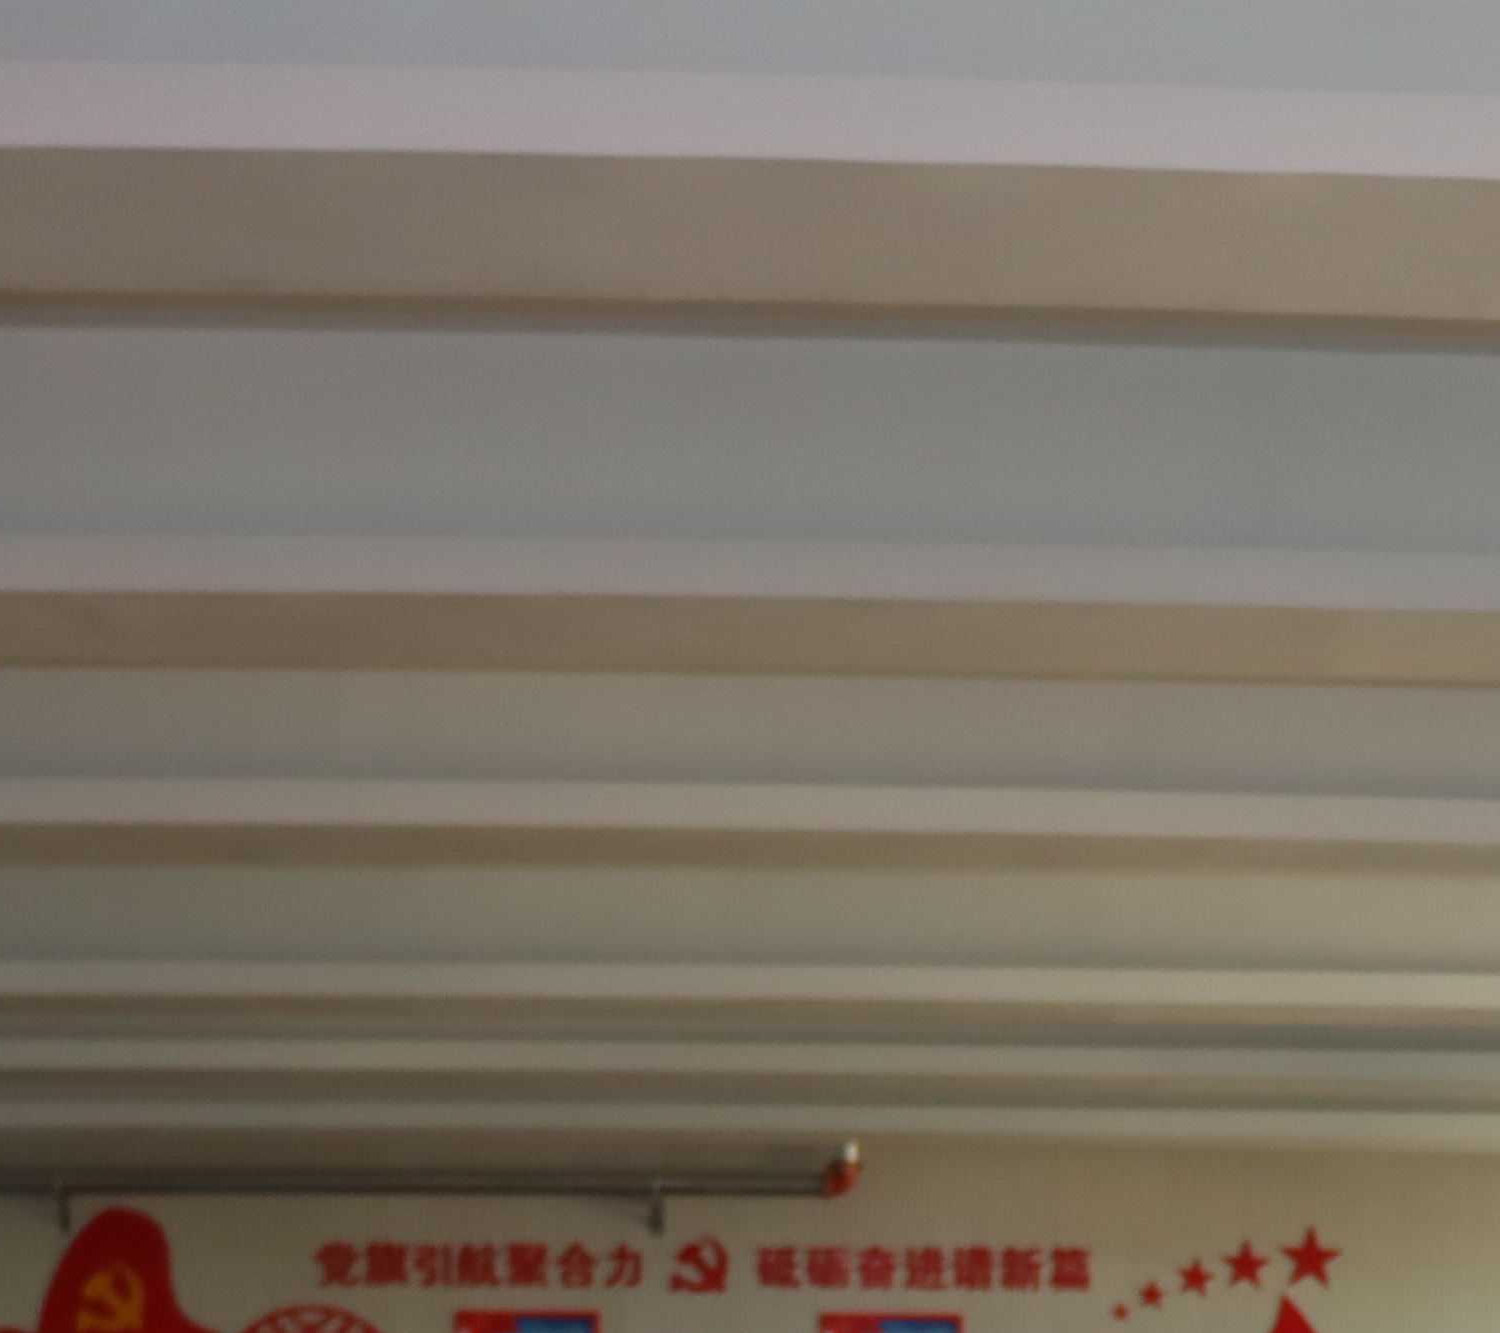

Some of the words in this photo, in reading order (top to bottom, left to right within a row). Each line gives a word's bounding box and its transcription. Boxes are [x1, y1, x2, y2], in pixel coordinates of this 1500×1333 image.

[314, 1241, 643, 1288] 党旗引航聚合力
[756, 1243, 1093, 1293] 砥砺奋进谱新篇
